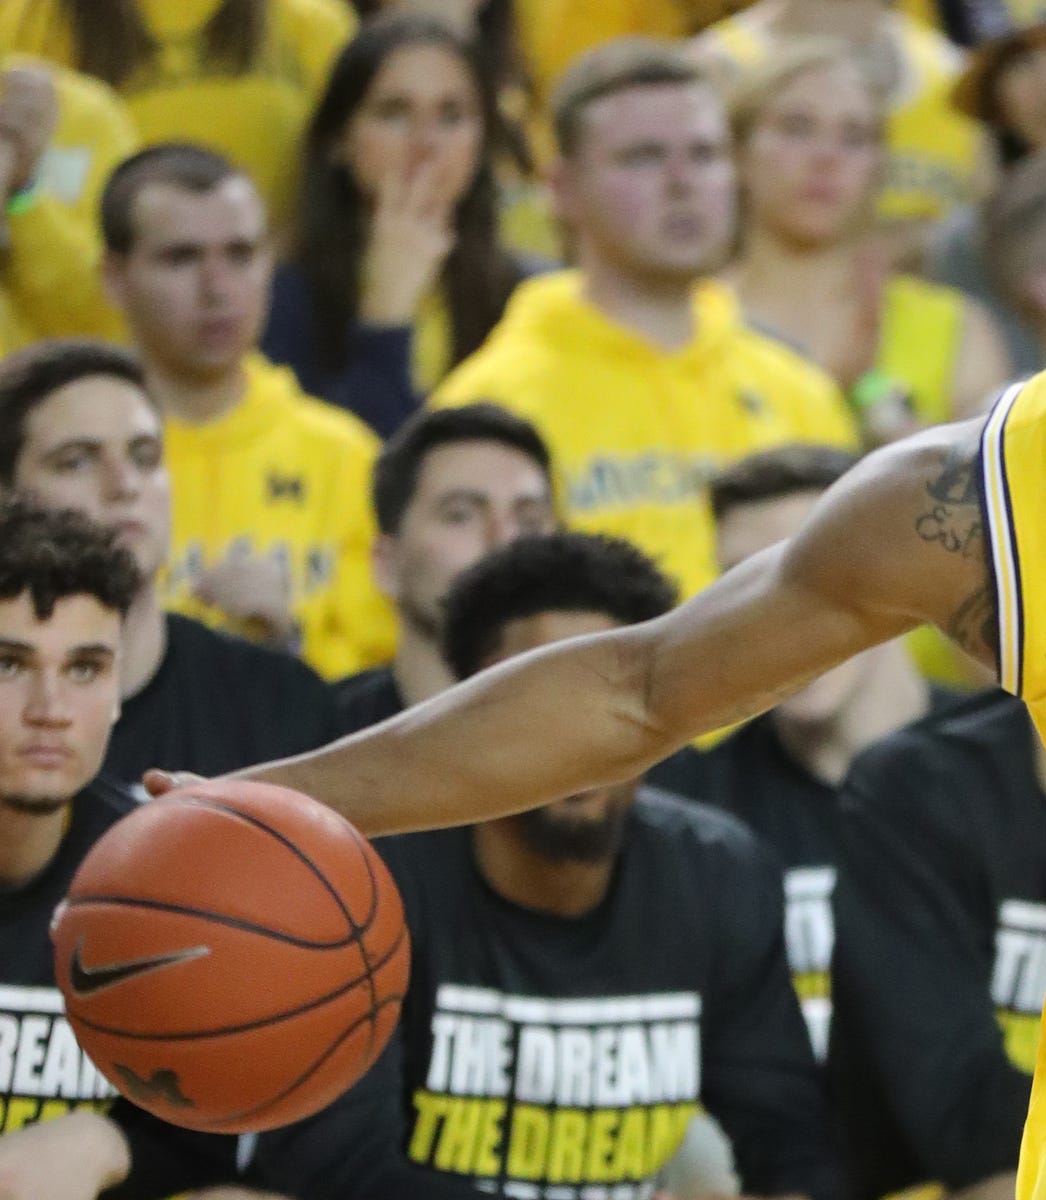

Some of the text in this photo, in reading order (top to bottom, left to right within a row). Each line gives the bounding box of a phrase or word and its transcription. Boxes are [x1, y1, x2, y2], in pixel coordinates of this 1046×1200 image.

[427, 1013, 698, 1106] THE DREAM
[409, 1090, 507, 1177] THE
